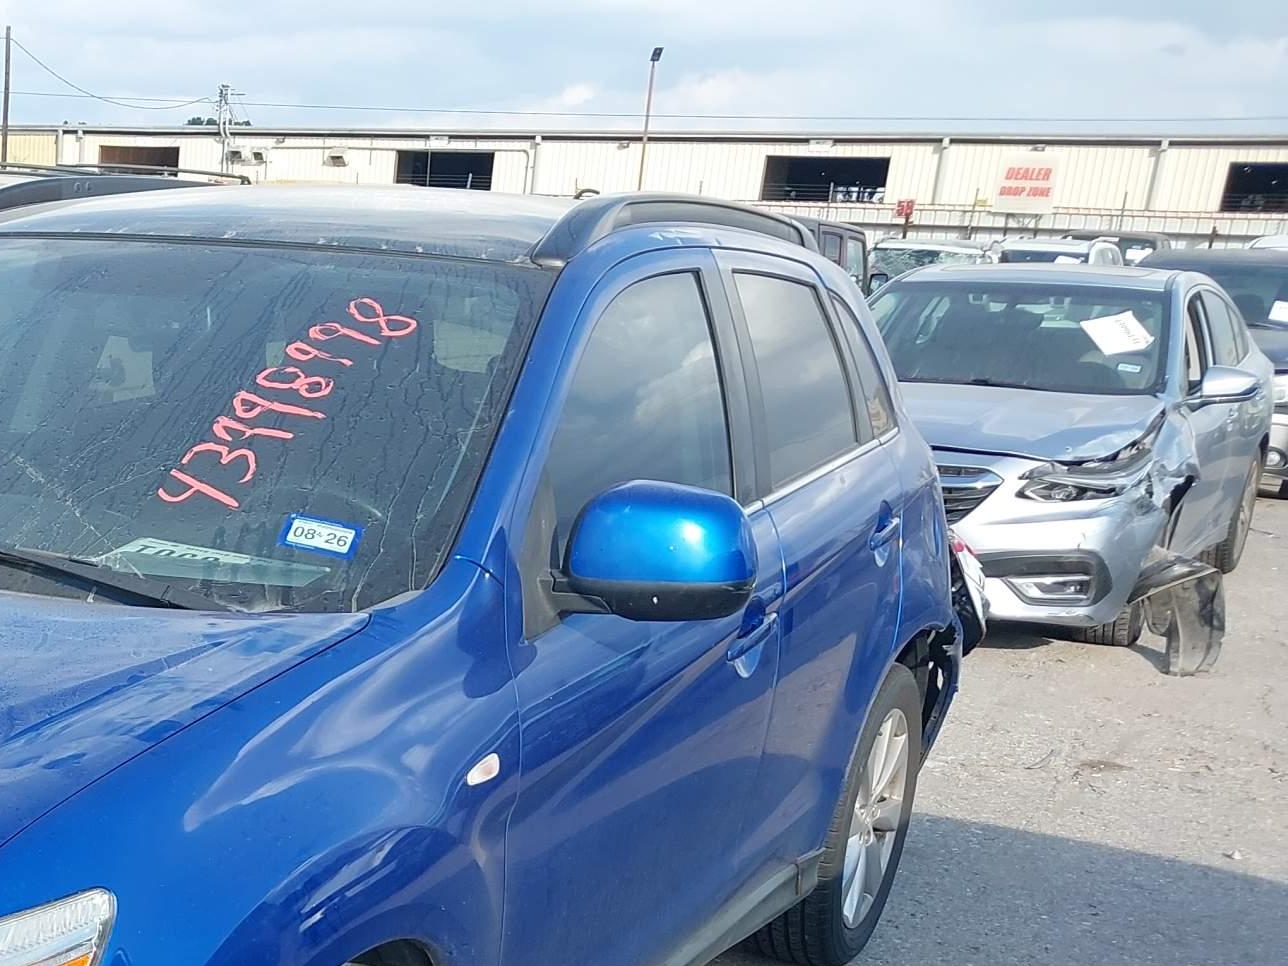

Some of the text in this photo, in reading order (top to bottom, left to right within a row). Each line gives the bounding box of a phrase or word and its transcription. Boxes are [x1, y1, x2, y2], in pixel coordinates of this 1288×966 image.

[1005, 167, 1052, 181] DEALER
[999, 186, 1052, 197] DROP ZONE
[157, 297, 418, 511] 43998998
